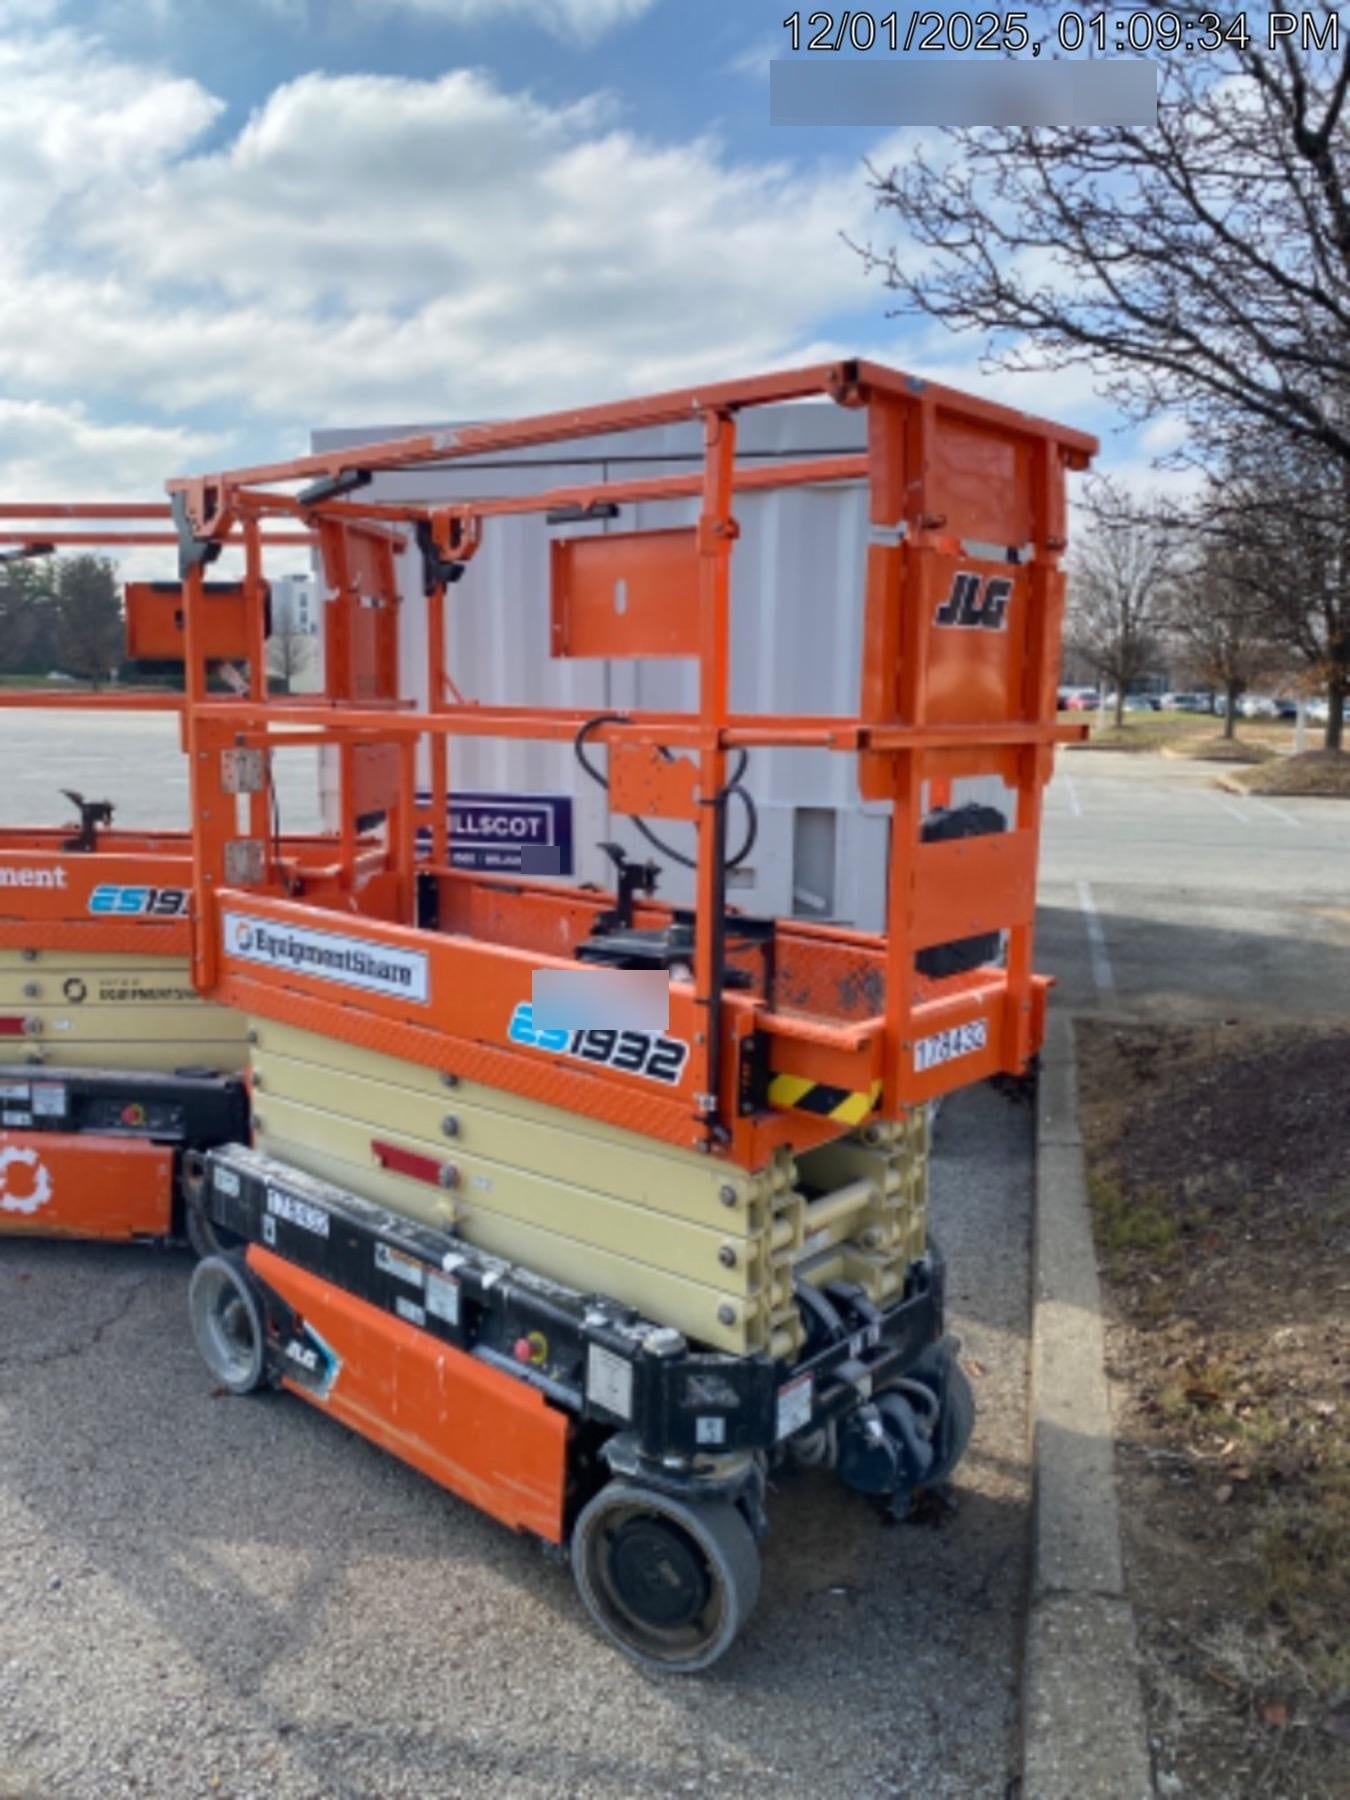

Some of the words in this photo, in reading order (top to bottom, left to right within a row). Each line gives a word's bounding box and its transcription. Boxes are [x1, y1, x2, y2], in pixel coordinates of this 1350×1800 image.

[935, 573, 1012, 630] JLG
[88, 884, 190, 917] ES19
[256, 928, 412, 986] EquipmentShare
